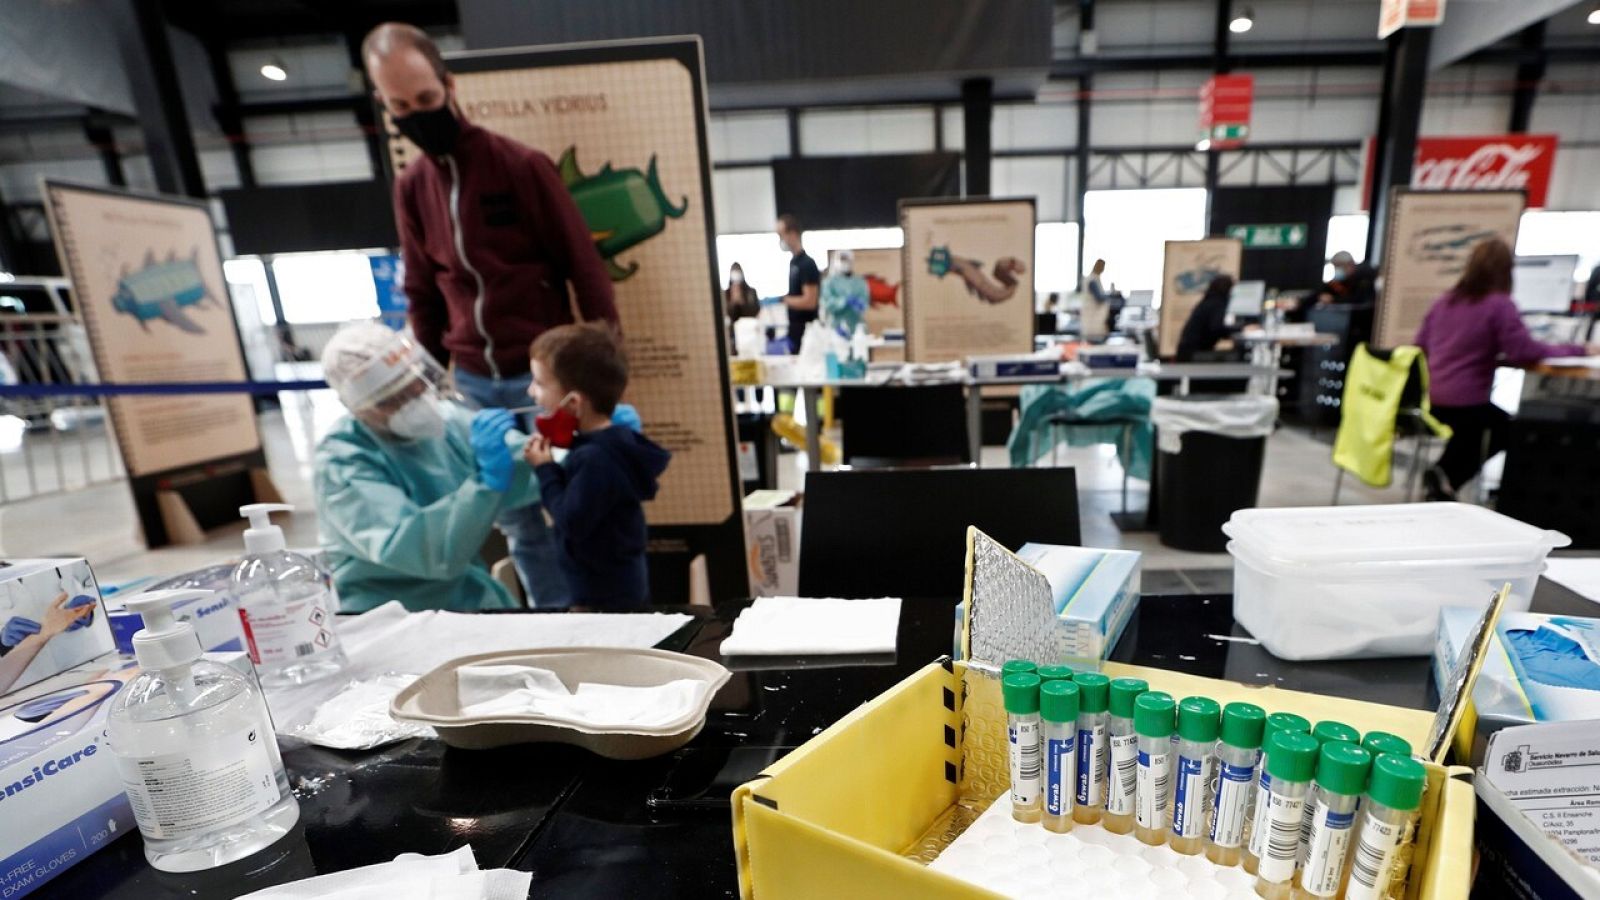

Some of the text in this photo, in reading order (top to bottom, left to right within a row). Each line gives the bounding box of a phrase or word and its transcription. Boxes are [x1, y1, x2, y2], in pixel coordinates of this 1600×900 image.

[1529, 753, 1554, 761] Servicio
[1520, 787, 1552, 796] estimada
[1562, 811, 1593, 819] Ensanche
[2, 848, 77, 899] EXAM GLOVES
